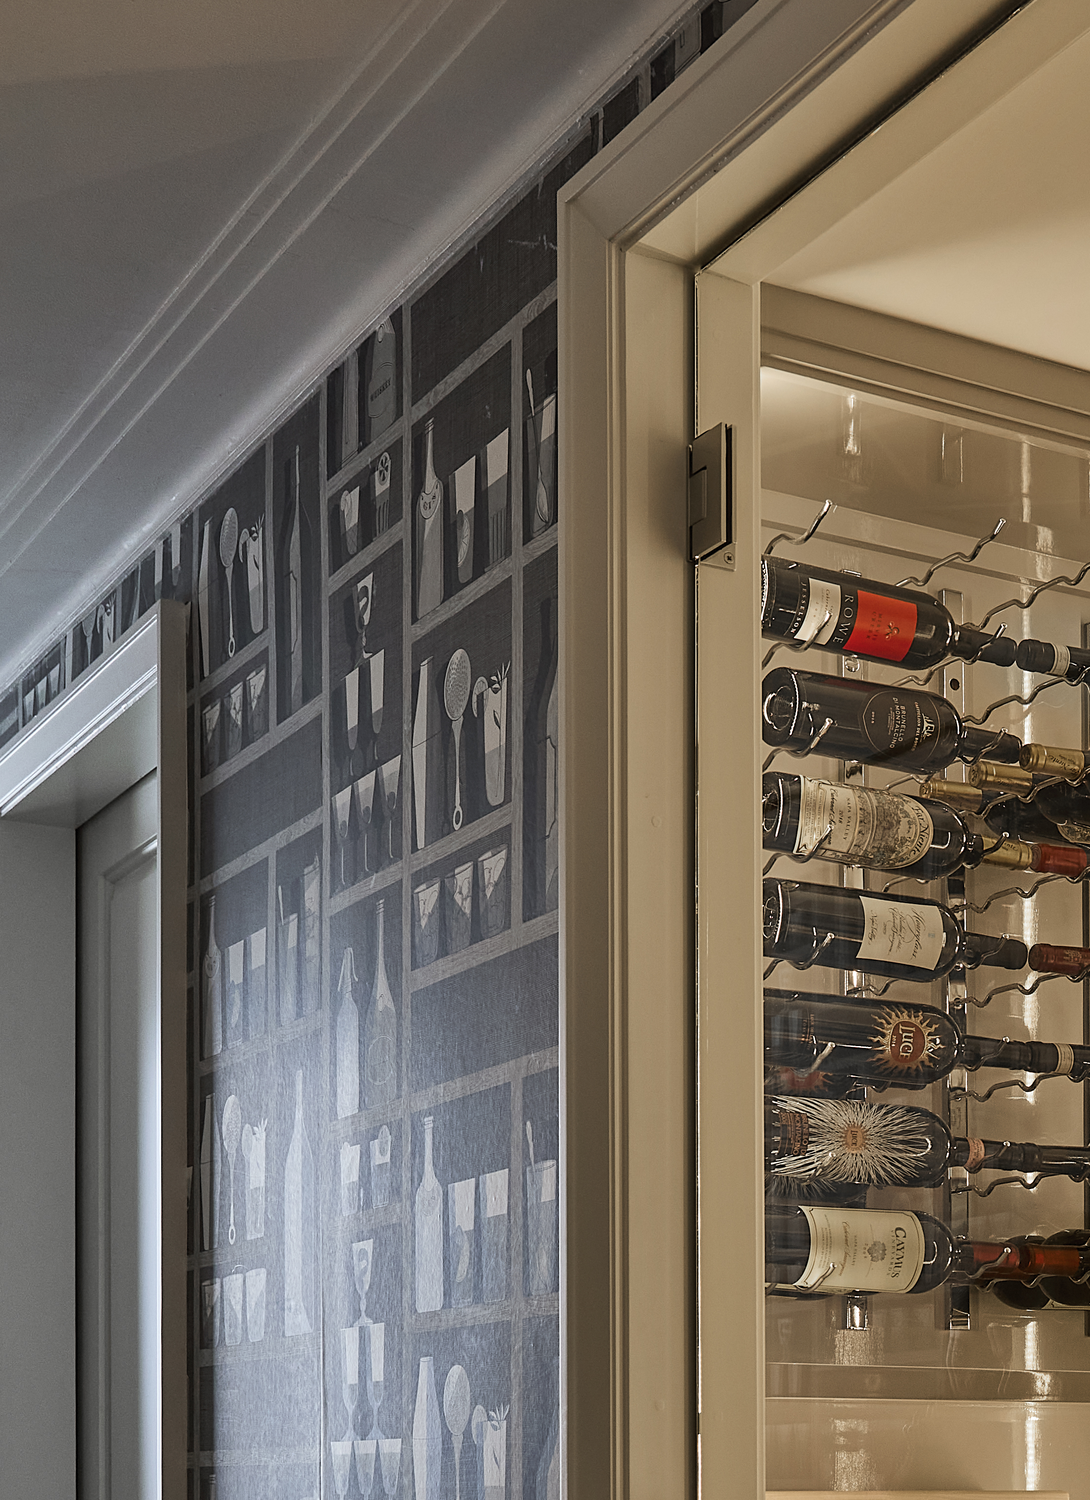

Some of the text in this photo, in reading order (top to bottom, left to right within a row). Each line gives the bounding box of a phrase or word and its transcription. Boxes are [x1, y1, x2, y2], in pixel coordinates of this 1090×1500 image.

[832, 594, 854, 644] ROWE
[889, 704, 901, 749] MONTALCINO
[898, 705, 907, 742] BRUNELLO
[911, 806, 930, 856] Far Niente
[891, 1227, 906, 1278] CAYMUS
